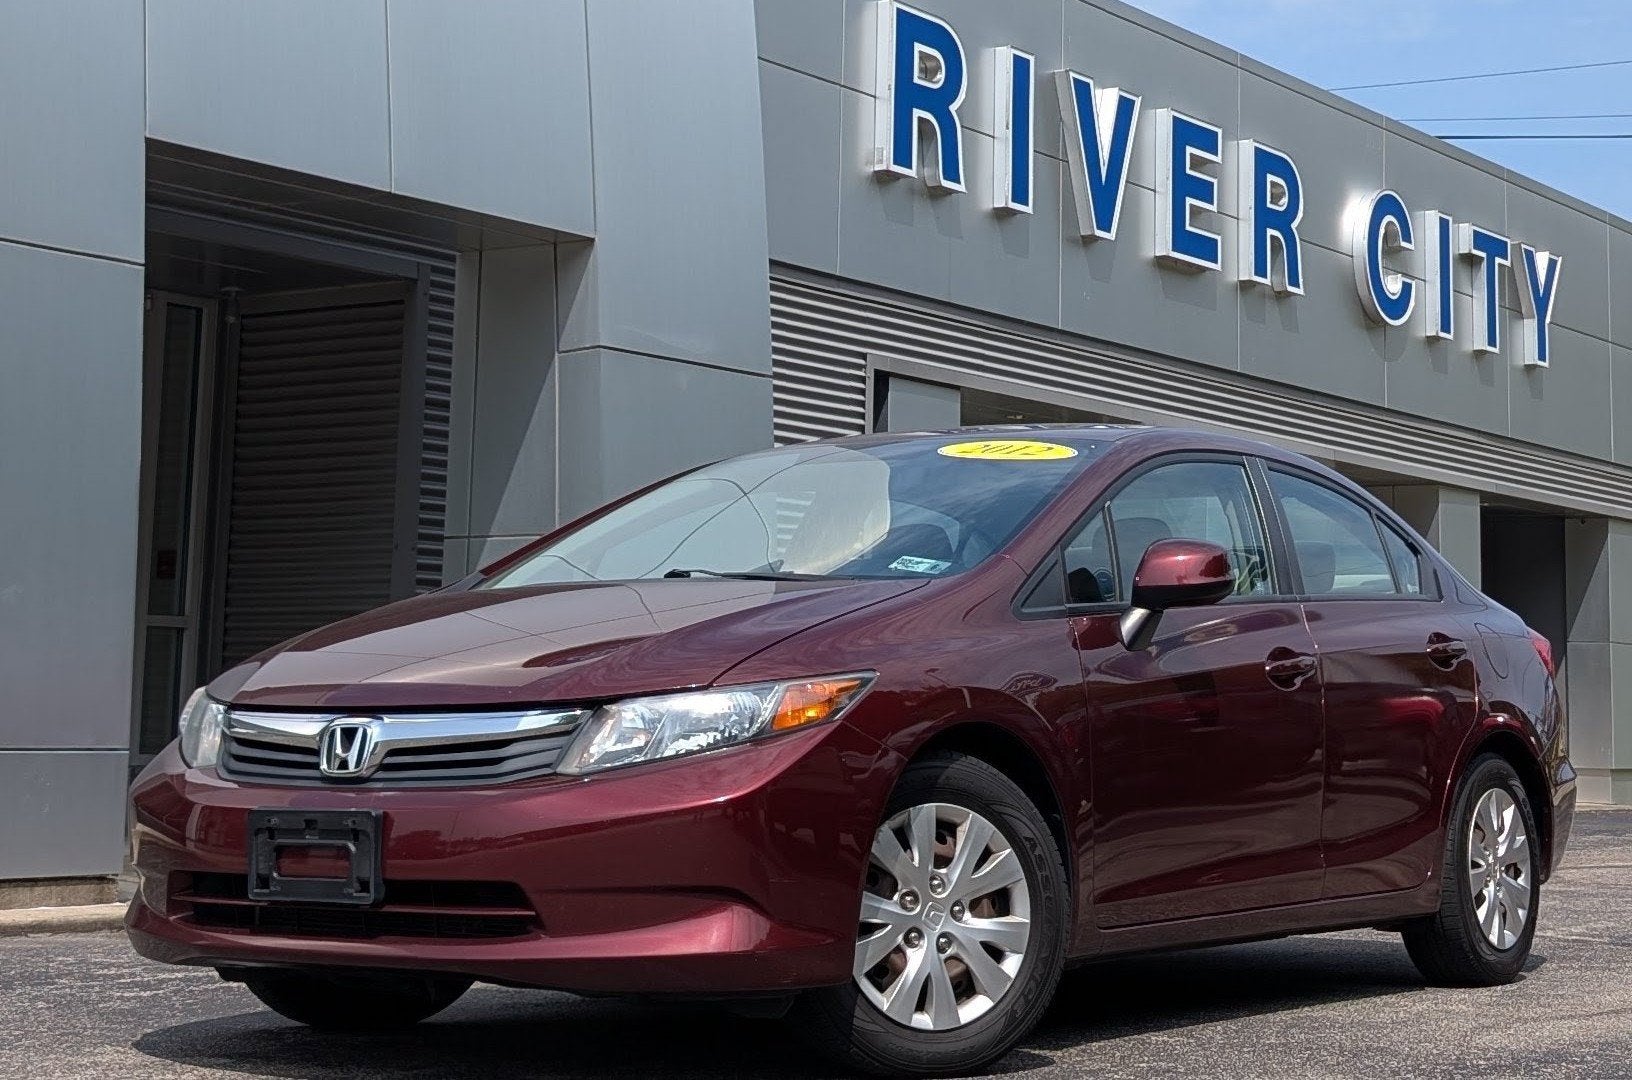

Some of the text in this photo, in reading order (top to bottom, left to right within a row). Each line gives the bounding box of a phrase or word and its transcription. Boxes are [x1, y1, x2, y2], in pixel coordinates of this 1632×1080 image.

[875, 0, 1562, 368] RIVER CITY
[955, 444, 1055, 456] 2012
